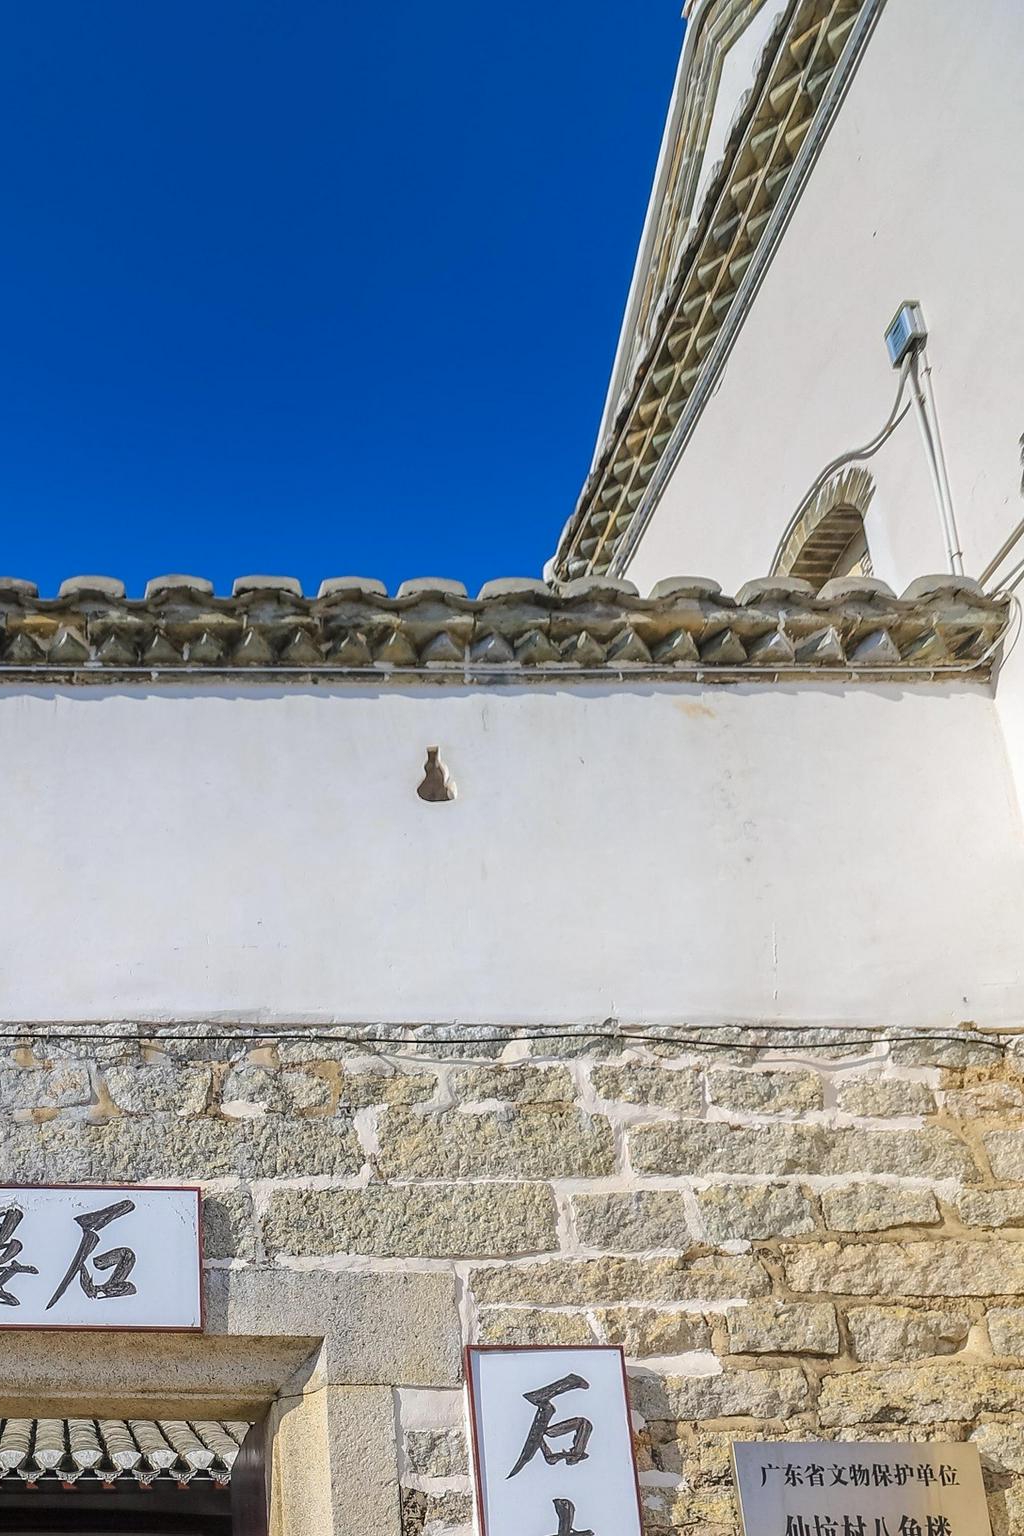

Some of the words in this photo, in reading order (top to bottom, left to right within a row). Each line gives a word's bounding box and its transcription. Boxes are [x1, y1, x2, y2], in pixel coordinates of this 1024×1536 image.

[760, 1463, 960, 1488] 广东省文物保护单位
